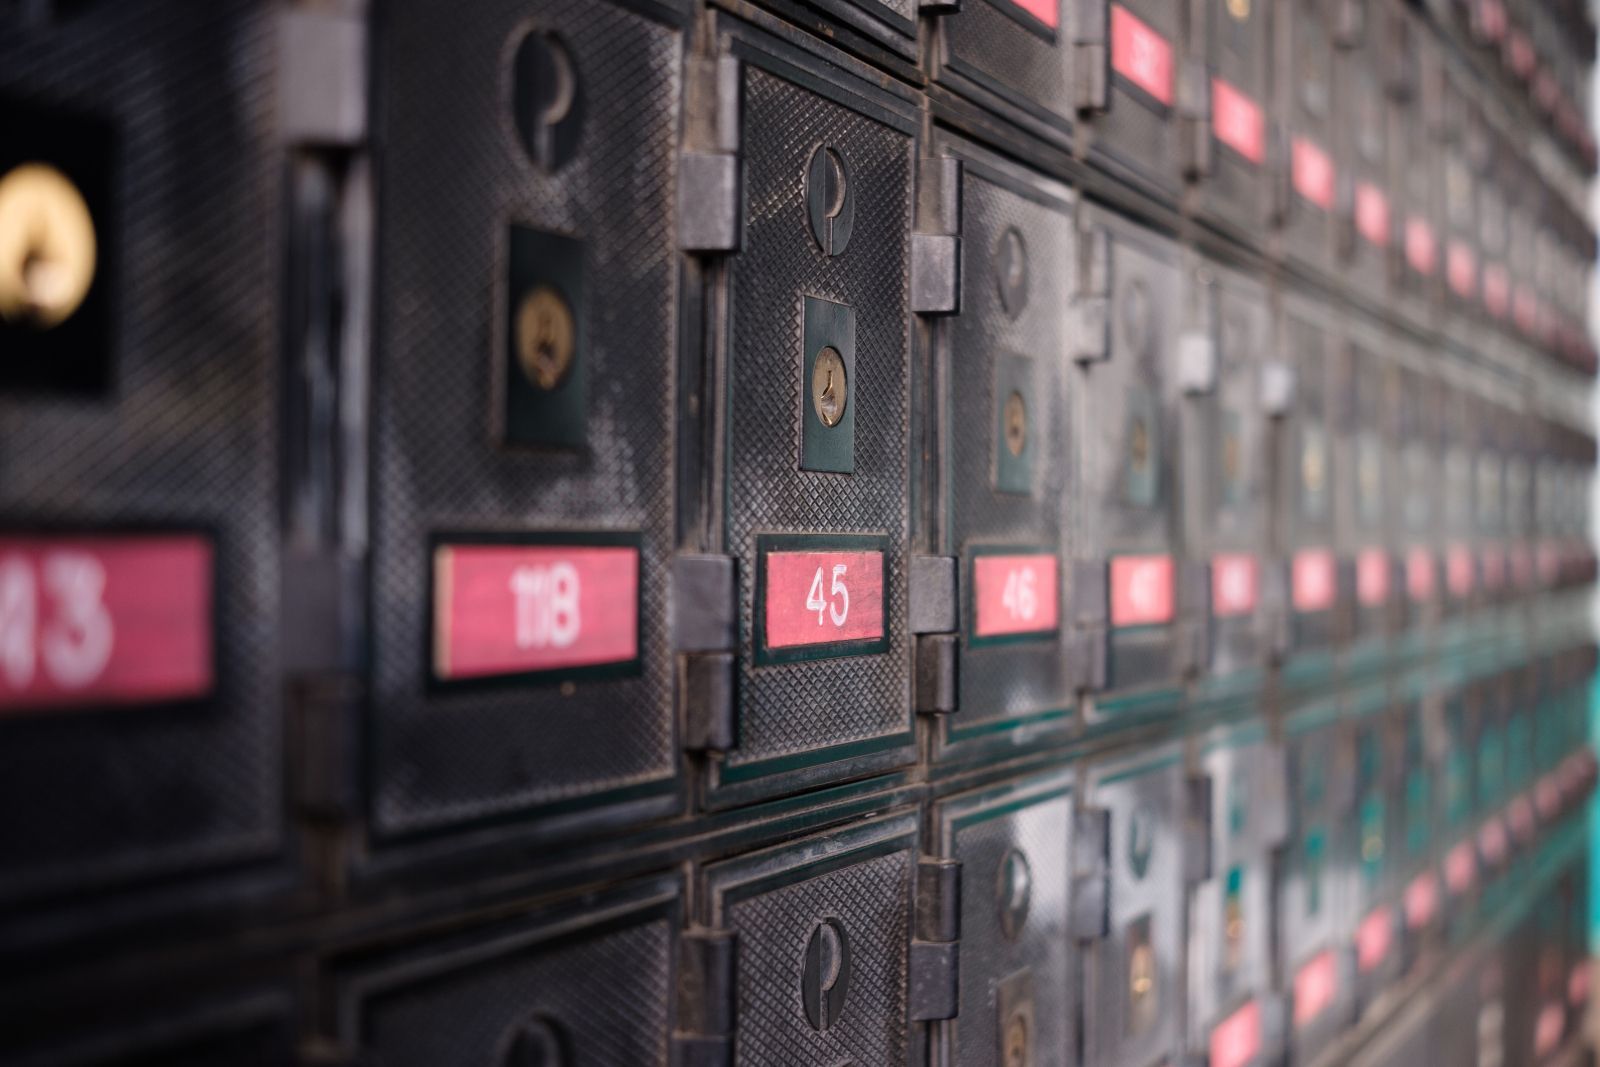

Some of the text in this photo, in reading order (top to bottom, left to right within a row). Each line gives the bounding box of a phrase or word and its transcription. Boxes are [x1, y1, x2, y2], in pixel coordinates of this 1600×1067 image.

[507, 561, 581, 649] 118
[806, 564, 849, 626] 45
[1002, 566, 1038, 621] 46
